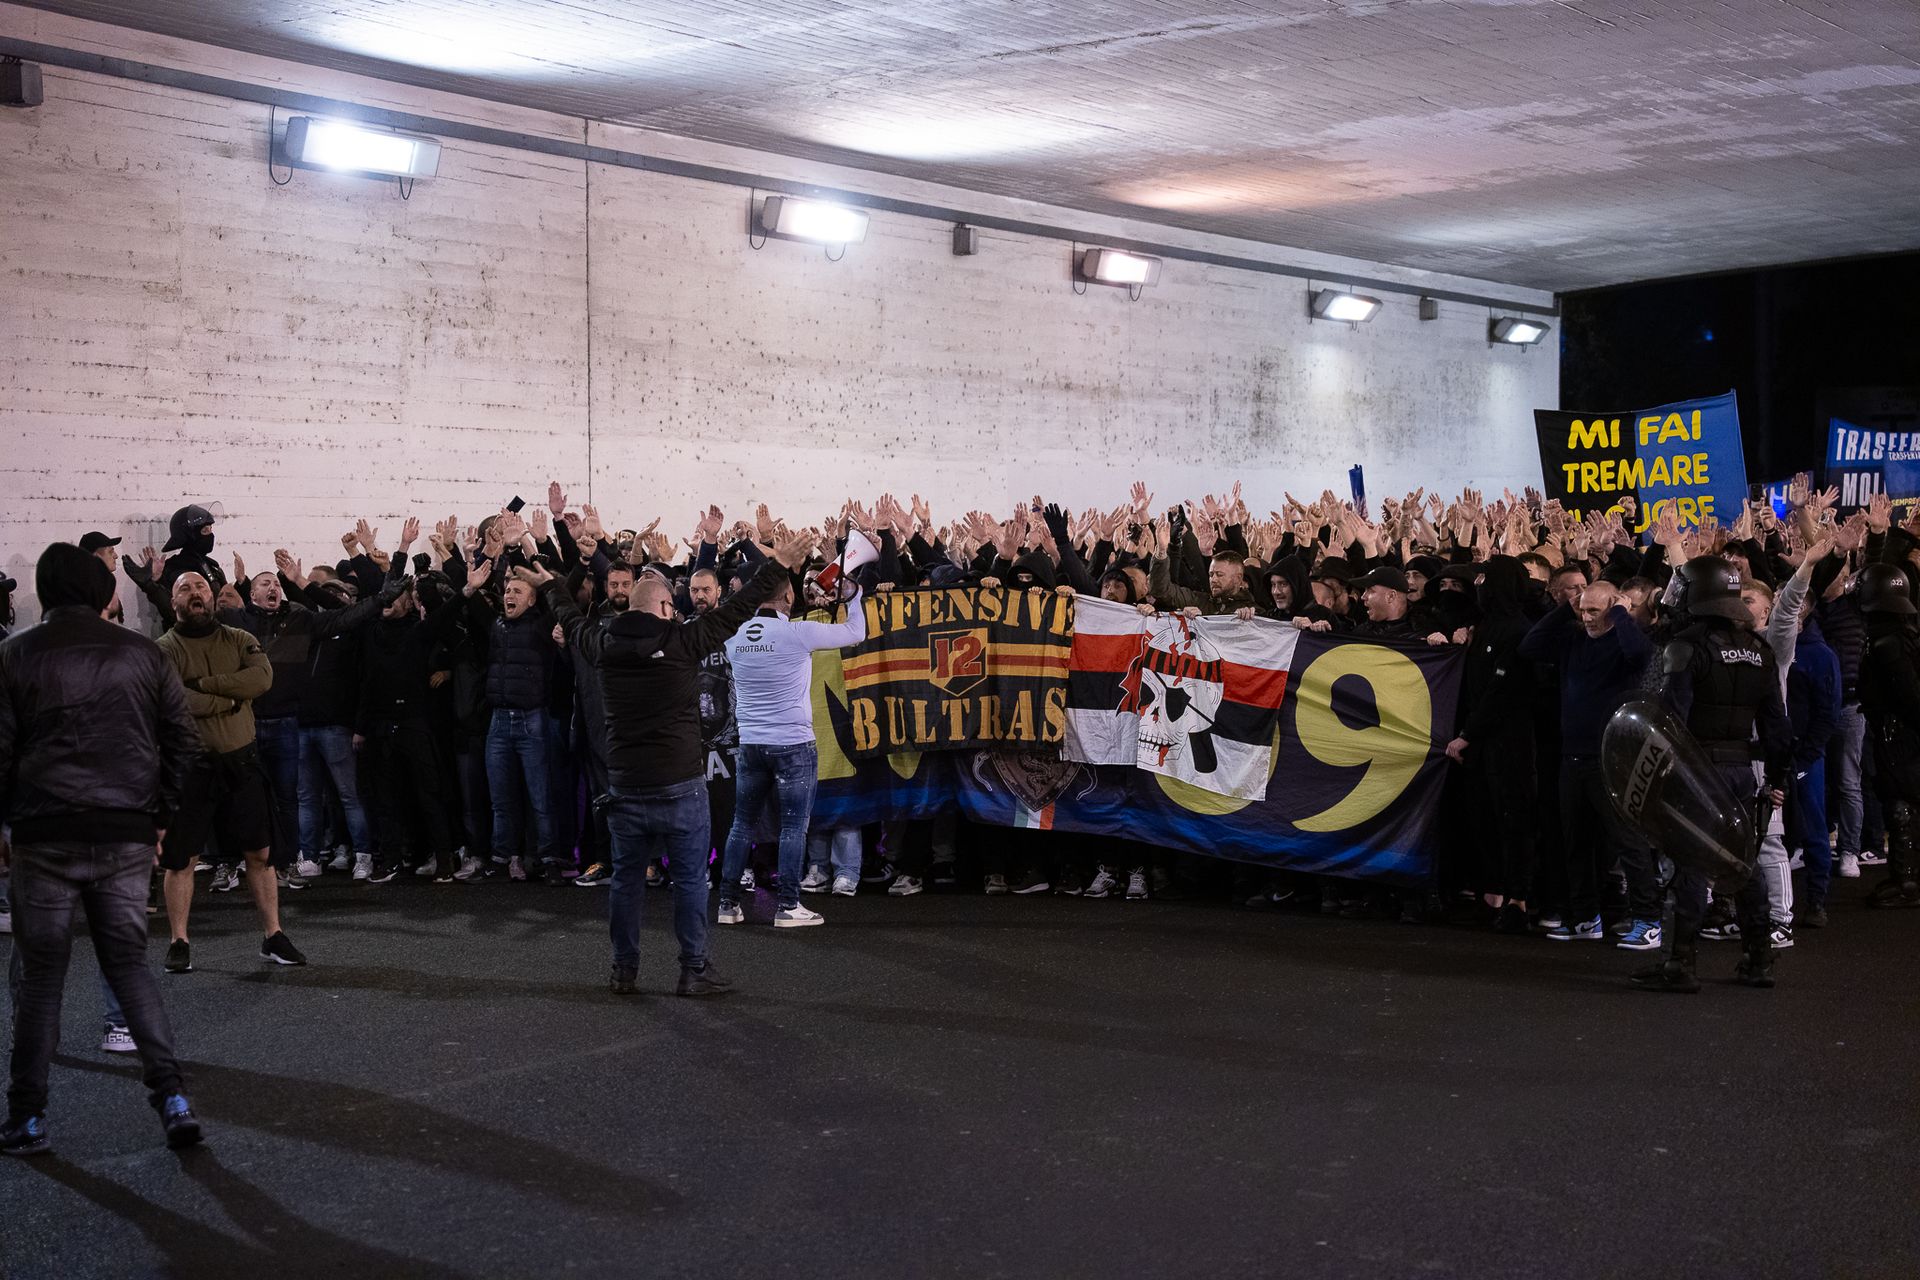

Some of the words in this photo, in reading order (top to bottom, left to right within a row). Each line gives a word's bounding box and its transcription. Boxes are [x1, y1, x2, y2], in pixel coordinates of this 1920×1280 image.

[1567, 419, 1621, 450] MI
[1639, 409, 1702, 446] FAI
[1562, 453, 1710, 493] TREMARE
[836, 588, 1074, 639] FFENSIVE
[735, 644, 774, 654] FOOTBALL
[935, 636, 982, 679] 12
[851, 687, 1067, 751] BULTRAS
